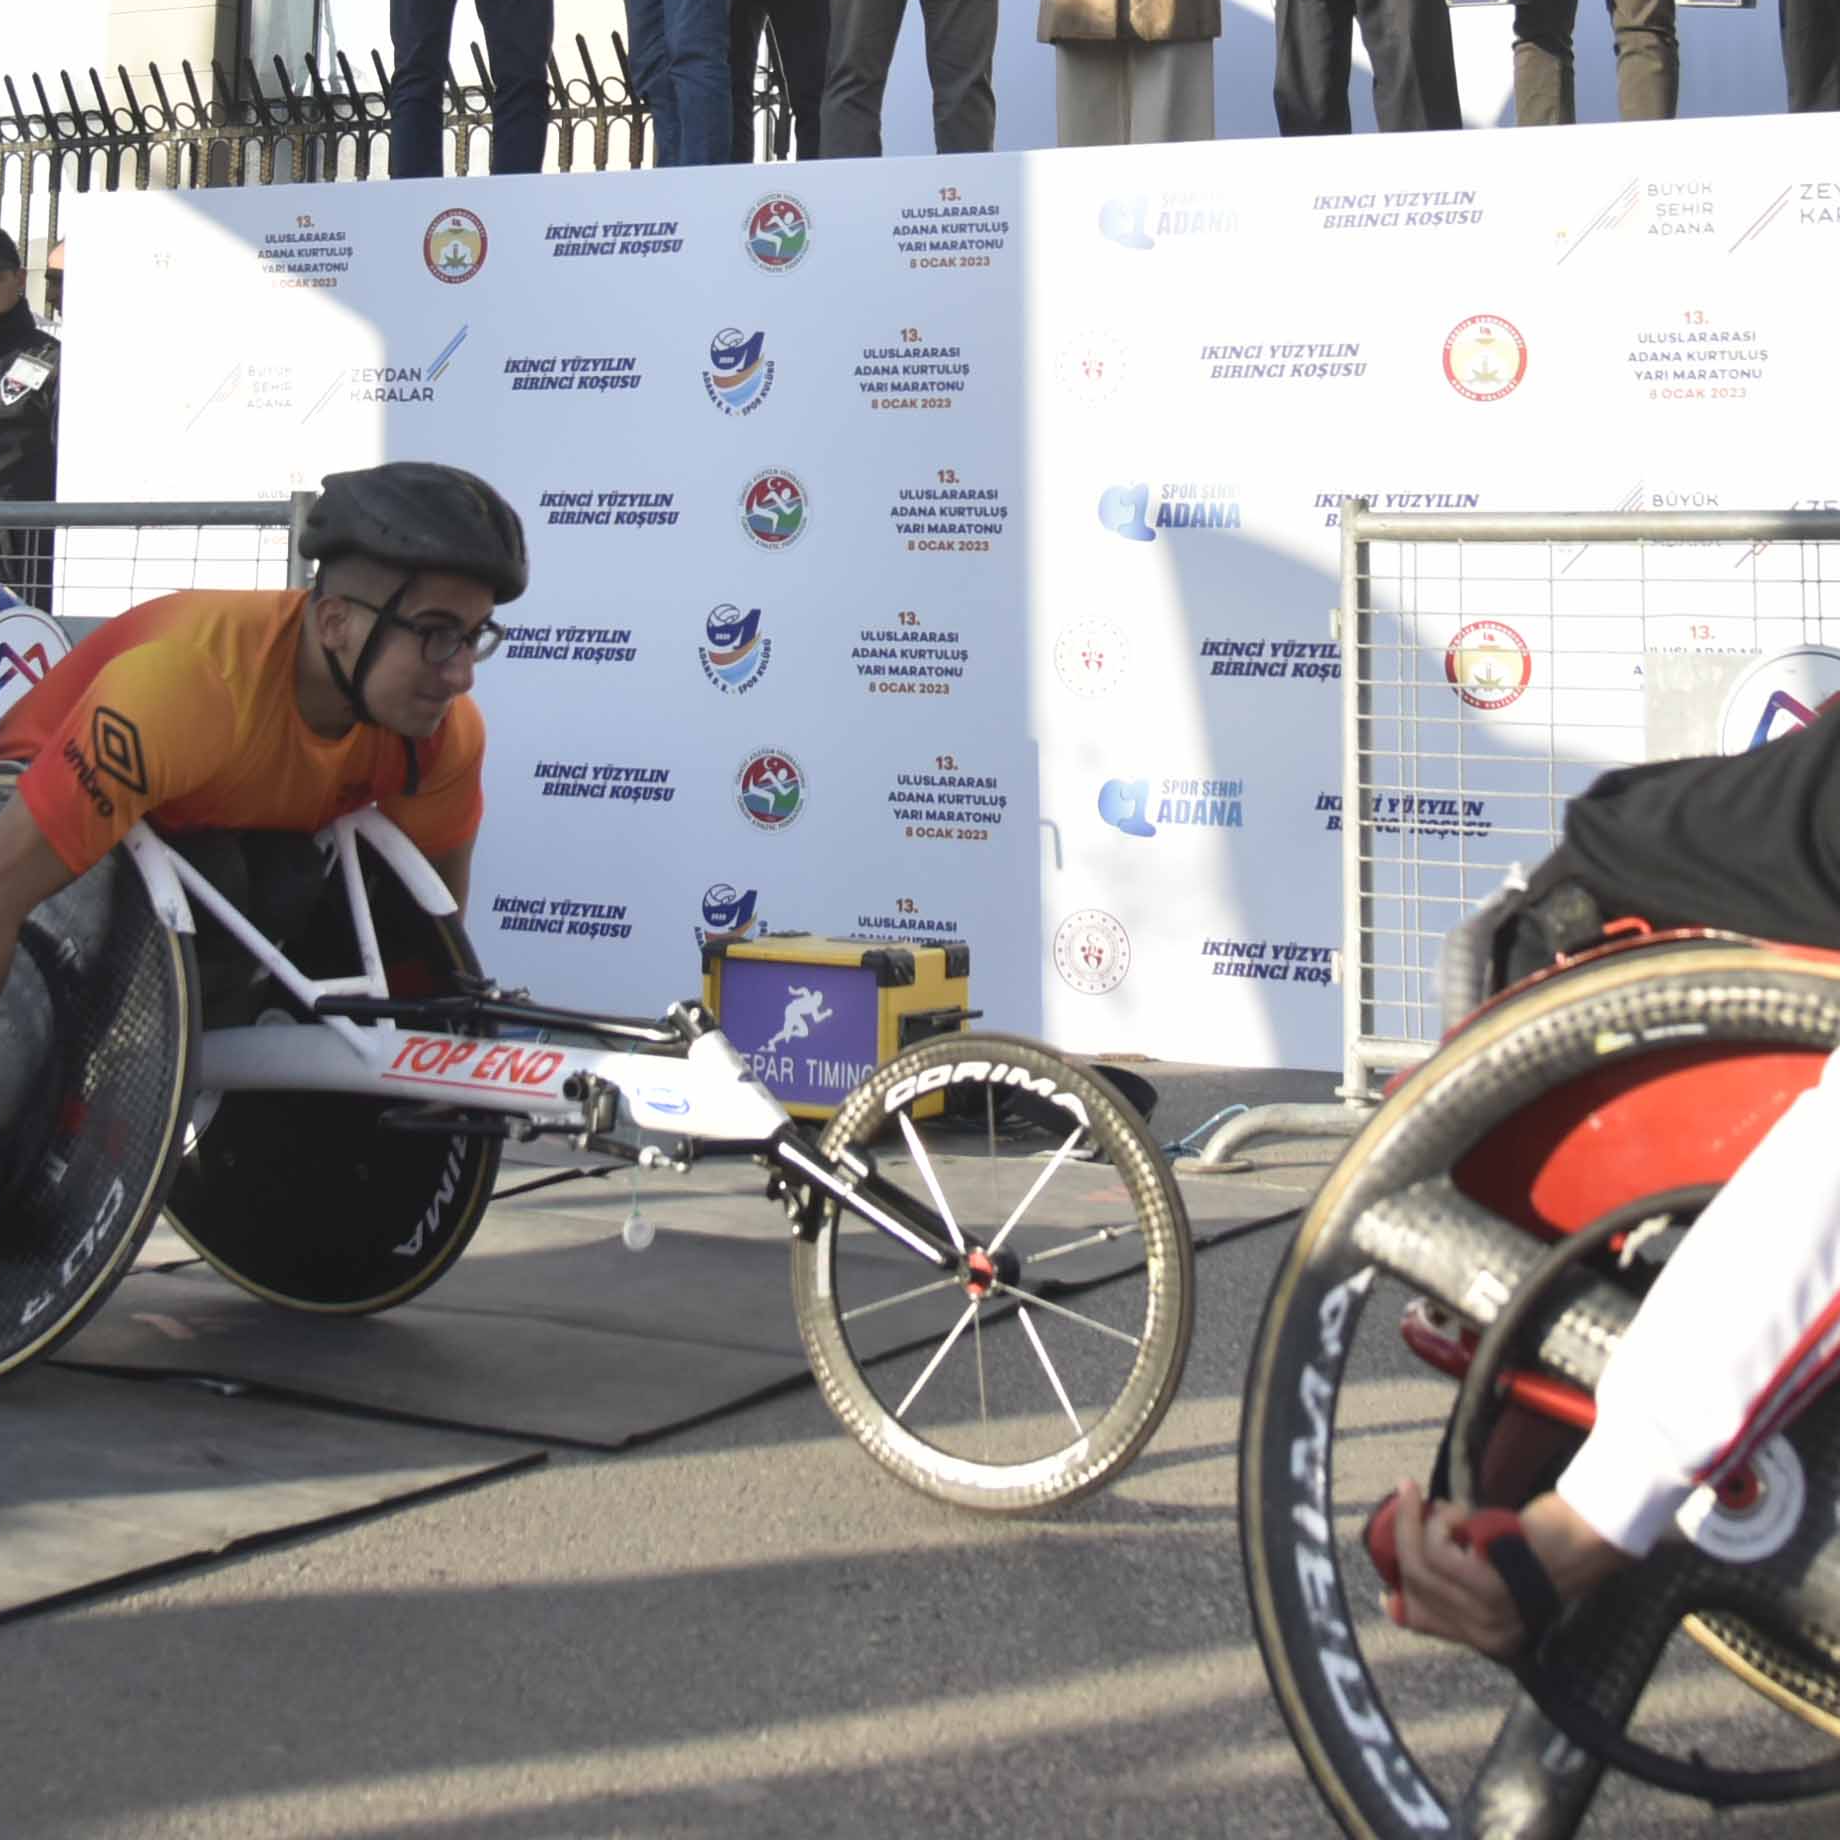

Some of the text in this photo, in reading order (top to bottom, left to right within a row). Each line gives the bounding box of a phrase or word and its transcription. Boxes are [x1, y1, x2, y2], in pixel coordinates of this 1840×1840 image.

[939, 187, 961, 201] 13.
[902, 205, 999, 219] ULUSLARARASI
[545, 221, 678, 241] İKİNCİ YÜZYILIN
[893, 221, 1009, 236] ADANA KURTULUŞ
[553, 239, 683, 257] BİRİNCİ KOŞUSU
[898, 238, 1004, 252] YARI MARATONU
[910, 256, 990, 268] 8 OCAK 2023
[504, 356, 636, 374] İKİNCİ YÜZYILIN
[351, 367, 422, 383] ZEYDAN
[512, 373, 642, 392] BİRİNCİ KOŞUSU
[937, 470, 959, 483] 13.
[539, 491, 674, 508] İKİNCİ YÜZYILIN
[900, 489, 998, 500] ULUSLARARASI
[548, 508, 680, 528] BİRİNCİ KOŞUSU
[890, 506, 1008, 519] ADANA KURTULUŞ
[896, 523, 1002, 534] YARI MARATONU
[908, 540, 989, 552] 8 OCAK 2023
[898, 612, 920, 626] 13.
[556, 626, 631, 644] YÜZYILIN
[861, 631, 959, 643] ULUSLARARASI
[506, 643, 636, 664] BİRİNCİ KOŞUSU
[852, 648, 968, 662] ADANA KURTULUŞ
[857, 664, 963, 677] YARI MARATONU
[869, 682, 949, 694] 8 OCAK 2023
[936, 756, 958, 770] 13.
[64, 738, 114, 817] umbro
[534, 762, 670, 783] İKİNCİ YÜZYILIN
[897, 774, 997, 789] ULUSLARARASI
[1161, 778, 1198, 795] SPOR
[542, 781, 675, 803] BİRİNCİ KOŞUSU
[888, 792, 1007, 808] ADANA KURTULUŞ
[894, 809, 1001, 823] YARI MARATONU
[1156, 800, 1244, 828] ADANA
[905, 827, 987, 840] 8 OCAK 2023
[492, 896, 626, 920] İKİNCİ YÜZYILIN
[500, 915, 632, 939] BİRİNCİ KOŞUSU
[391, 1036, 566, 1086] TOP END
[740, 1052, 794, 1084] EPAR
[884, 1061, 1090, 1127] CORIMA
